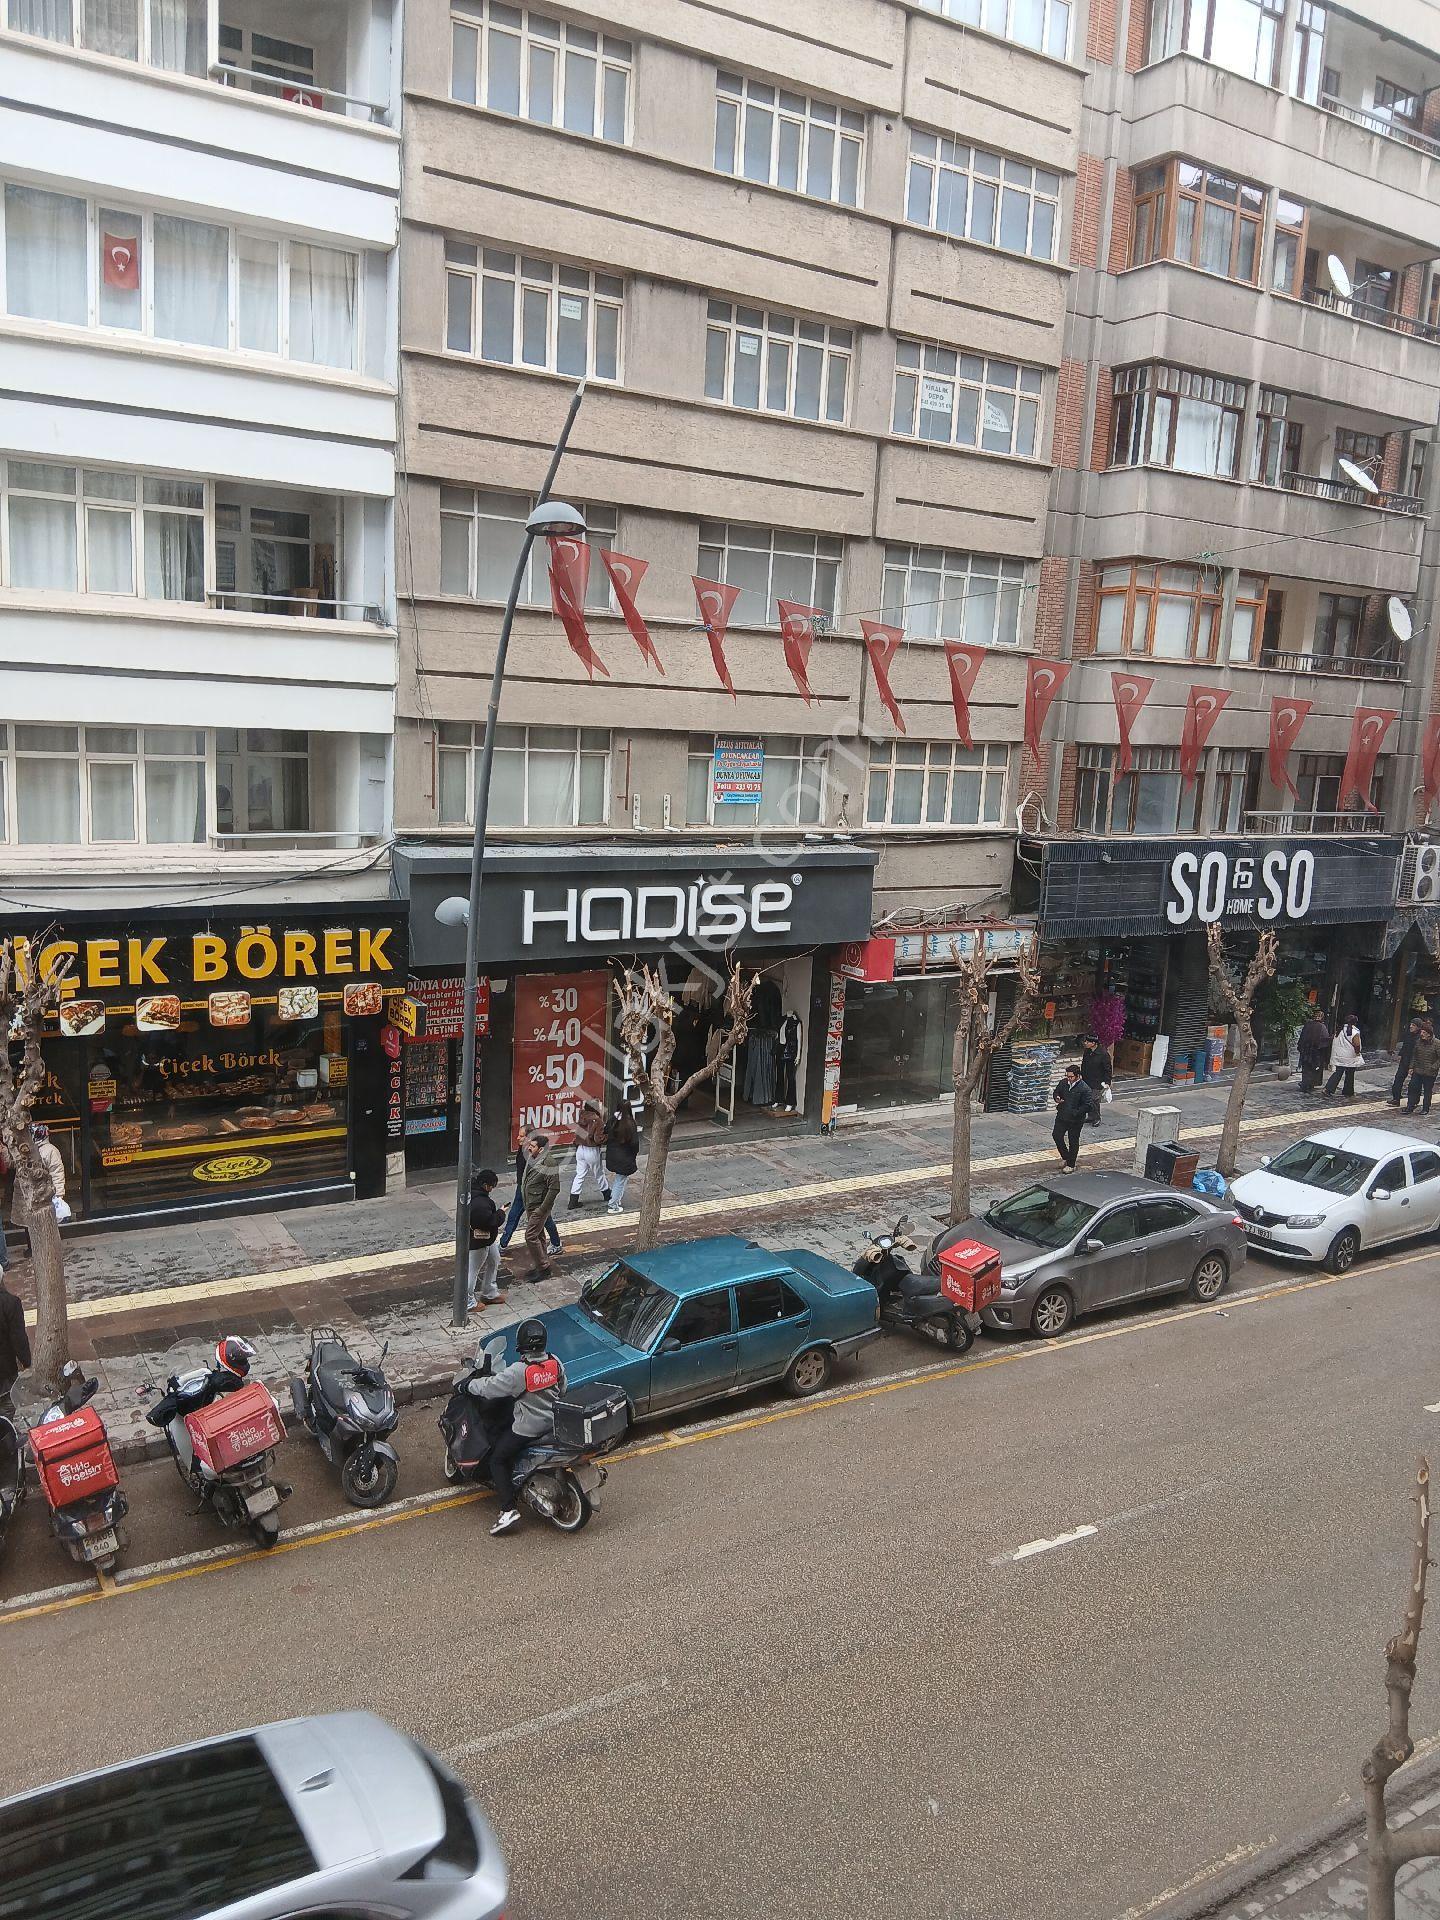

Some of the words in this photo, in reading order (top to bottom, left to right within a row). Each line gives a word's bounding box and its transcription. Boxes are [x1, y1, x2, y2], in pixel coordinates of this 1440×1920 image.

[1166, 851, 1228, 925] SO
[1257, 850, 1315, 919] SO
[1226, 899, 1254, 914] HOME
[0, 936, 170, 1000] İÇEK
[193, 926, 394, 982] BÖREK
[441, 976, 488, 990] OYUNAK
[539, 987, 578, 1013] %30
[533, 1017, 581, 1047] %40
[159, 1054, 219, 1079] Çiçek
[220, 1048, 284, 1069] Börek
[528, 1052, 585, 1090] %50
